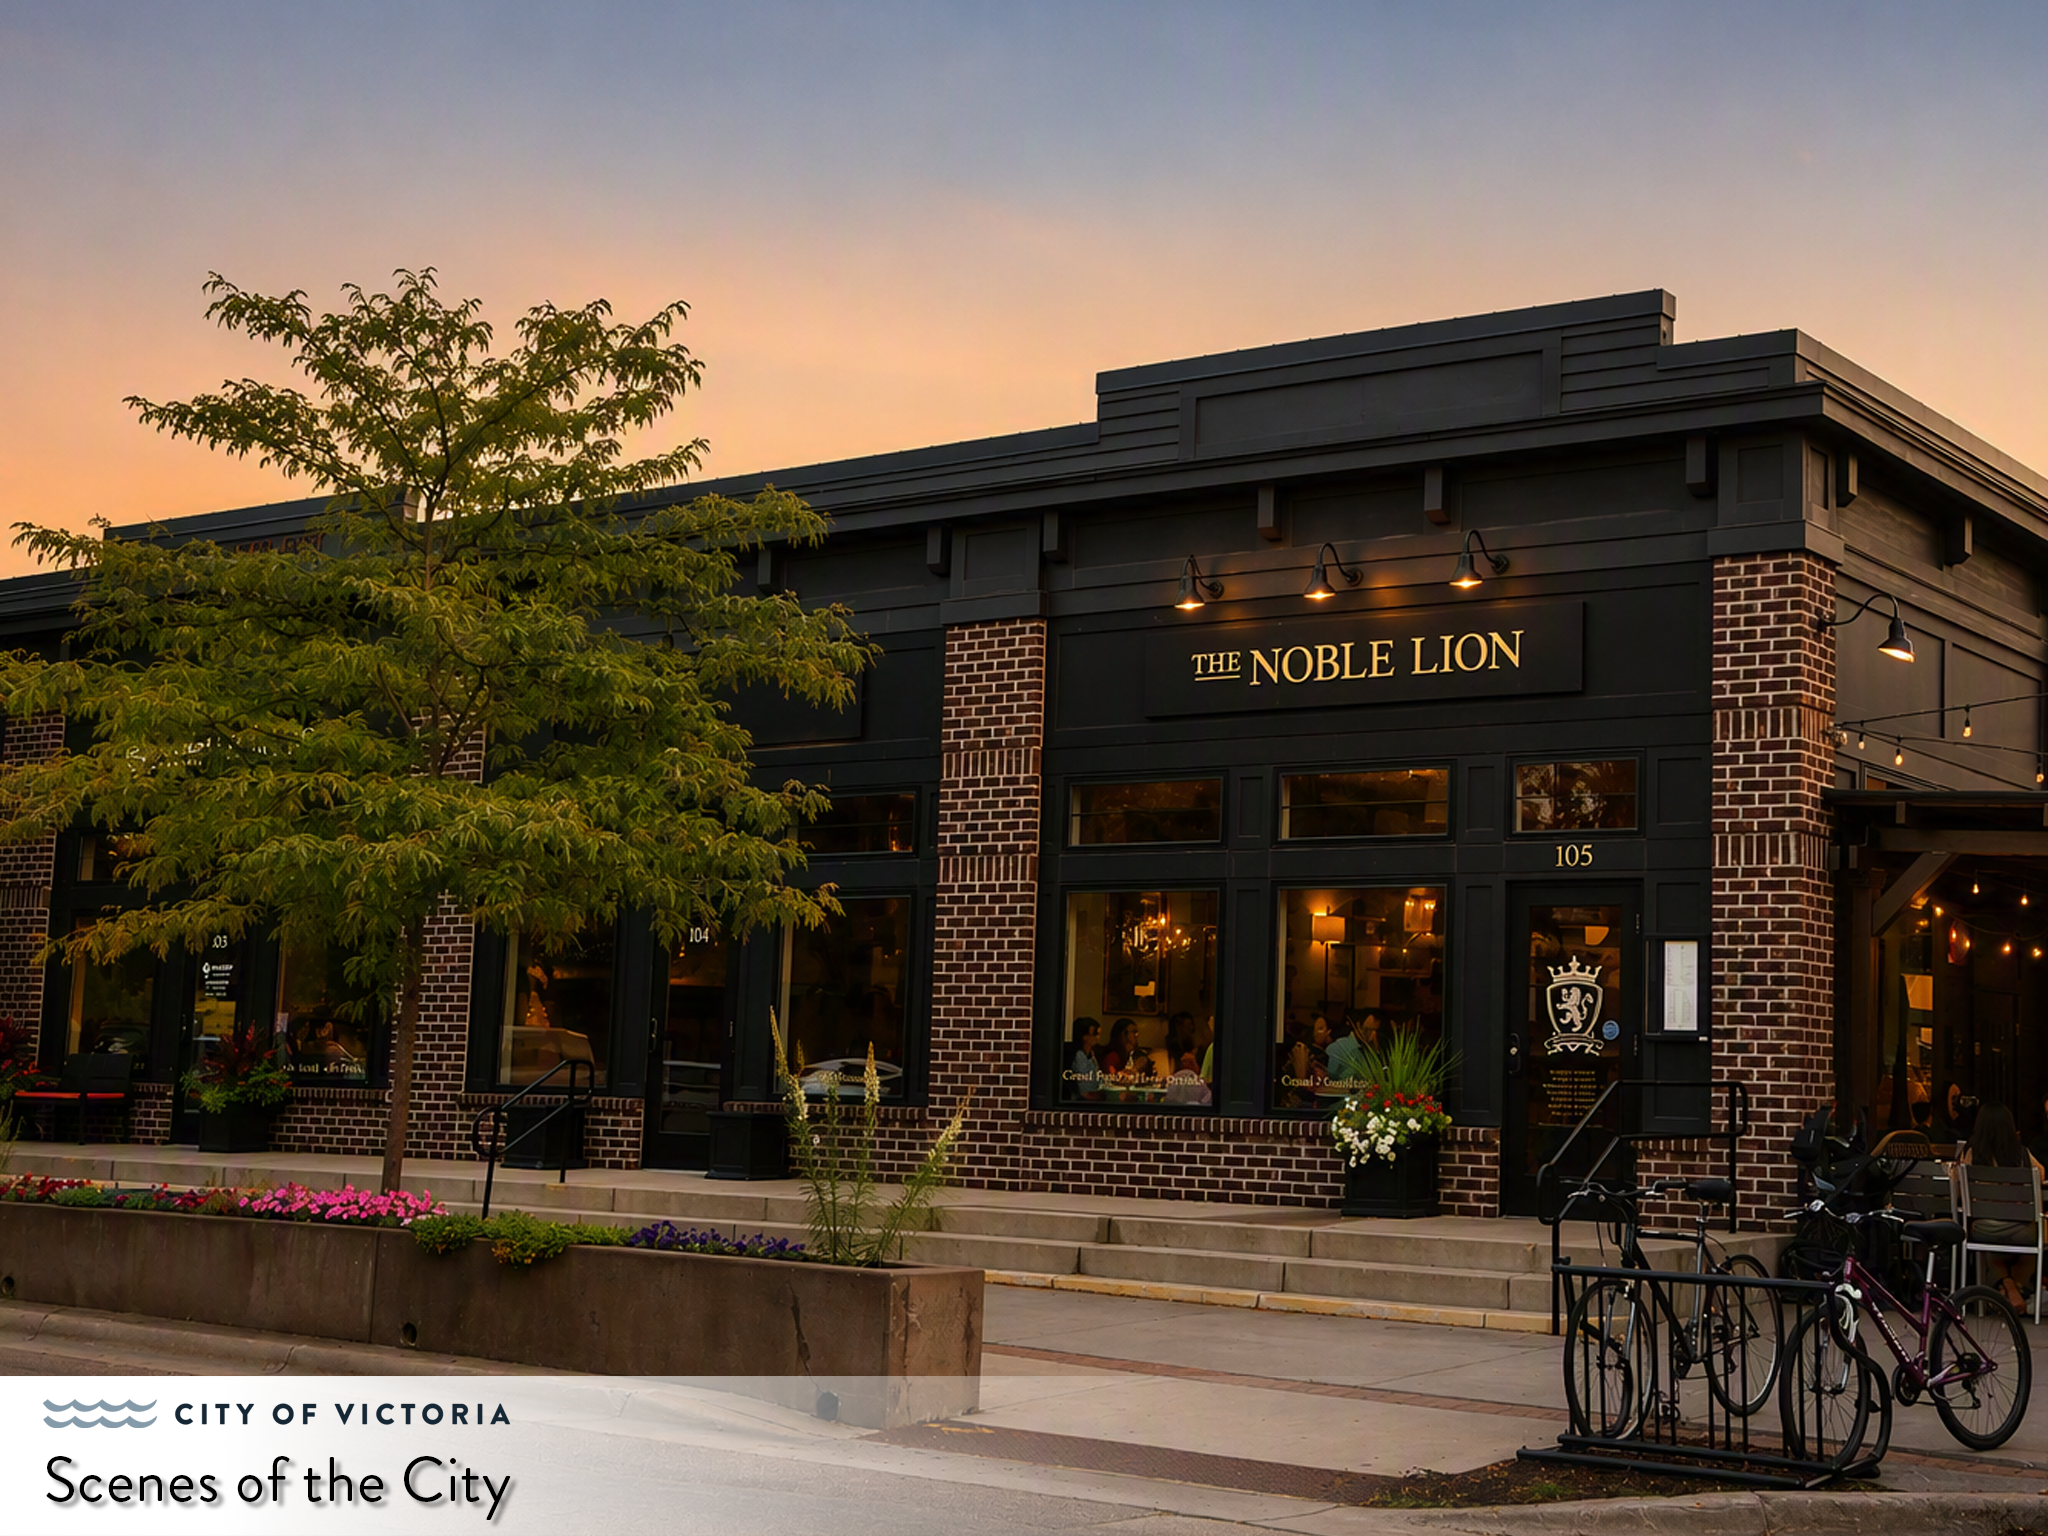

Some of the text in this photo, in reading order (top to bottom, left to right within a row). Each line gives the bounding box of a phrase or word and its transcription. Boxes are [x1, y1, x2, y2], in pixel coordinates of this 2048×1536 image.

[1191, 629, 1524, 686] THE NOBLE LION
[1555, 844, 1593, 868] 105
[689, 927, 709, 943] 104
